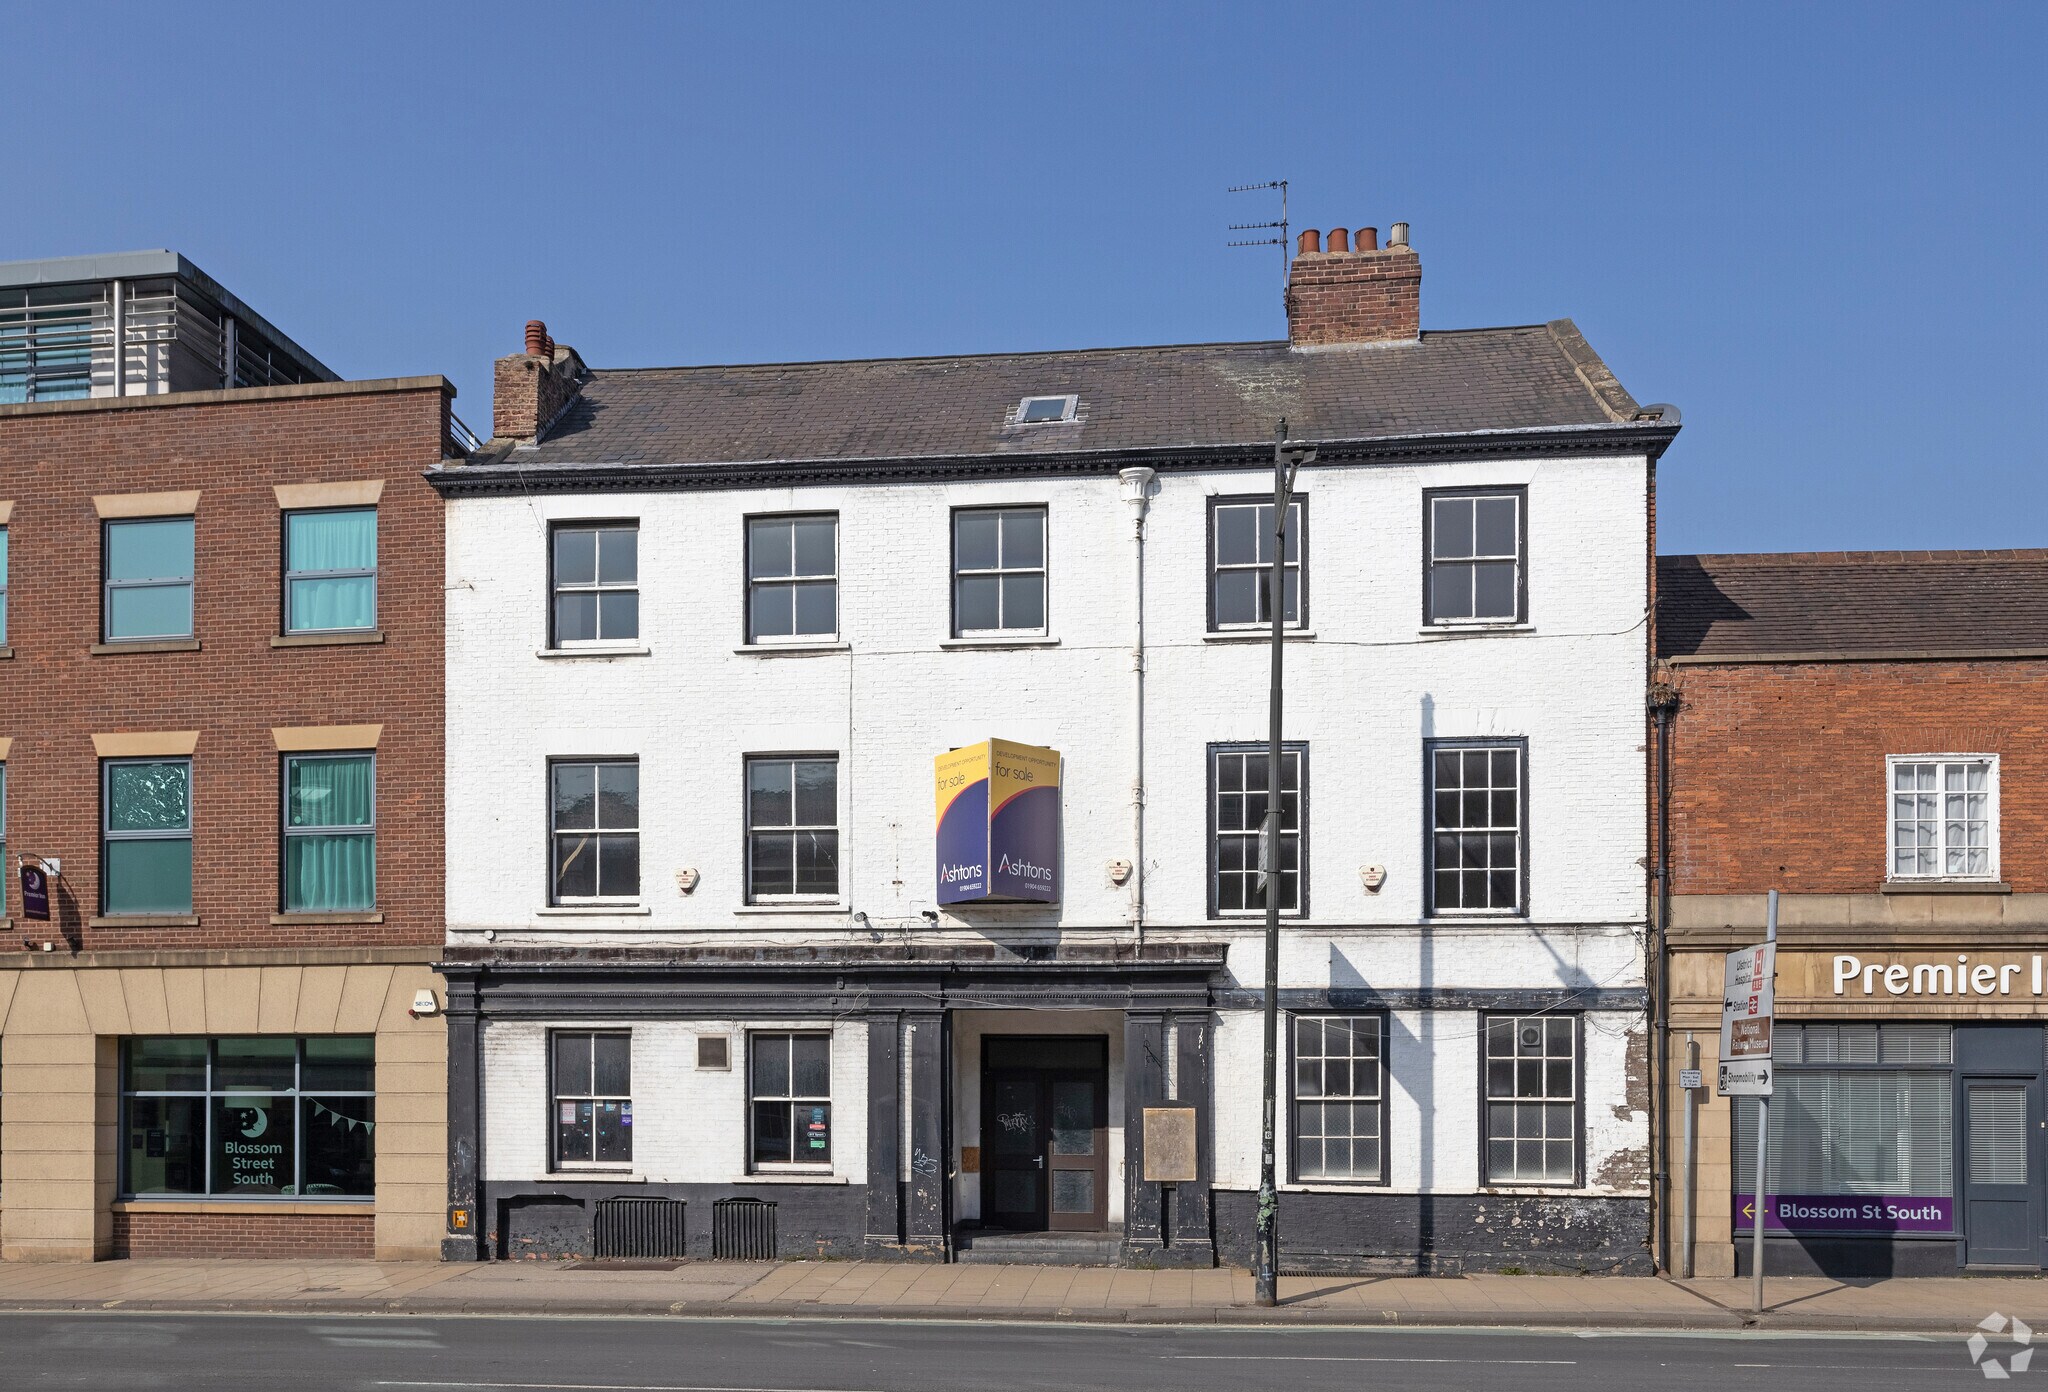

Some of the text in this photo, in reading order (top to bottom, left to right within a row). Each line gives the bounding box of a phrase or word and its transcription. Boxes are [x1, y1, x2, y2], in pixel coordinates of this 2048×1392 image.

[938, 754, 986, 772] DEVELOPMENT OPPORTUNITY
[996, 750, 1056, 768] DEVELOPMENT OPPORTUNITY
[995, 762, 1033, 782] for sale
[938, 772, 965, 790] for sale
[940, 863, 982, 884] Ashtons
[998, 853, 1052, 881] Ashtons
[1737, 958, 1752, 970] District
[1735, 973, 1751, 986] Hospital
[1833, 954, 2048, 995] Premier I
[1733, 999, 1748, 1012] Station
[1740, 1022, 1760, 1035] National
[1749, 1038, 1768, 1049] Museum
[1728, 1072, 1756, 1084] Shopmobility
[225, 1142, 282, 1154] Blossom
[232, 1157, 274, 1169] Street
[234, 1172, 273, 1184] South
[1779, 1203, 1942, 1220] Blossom St South
